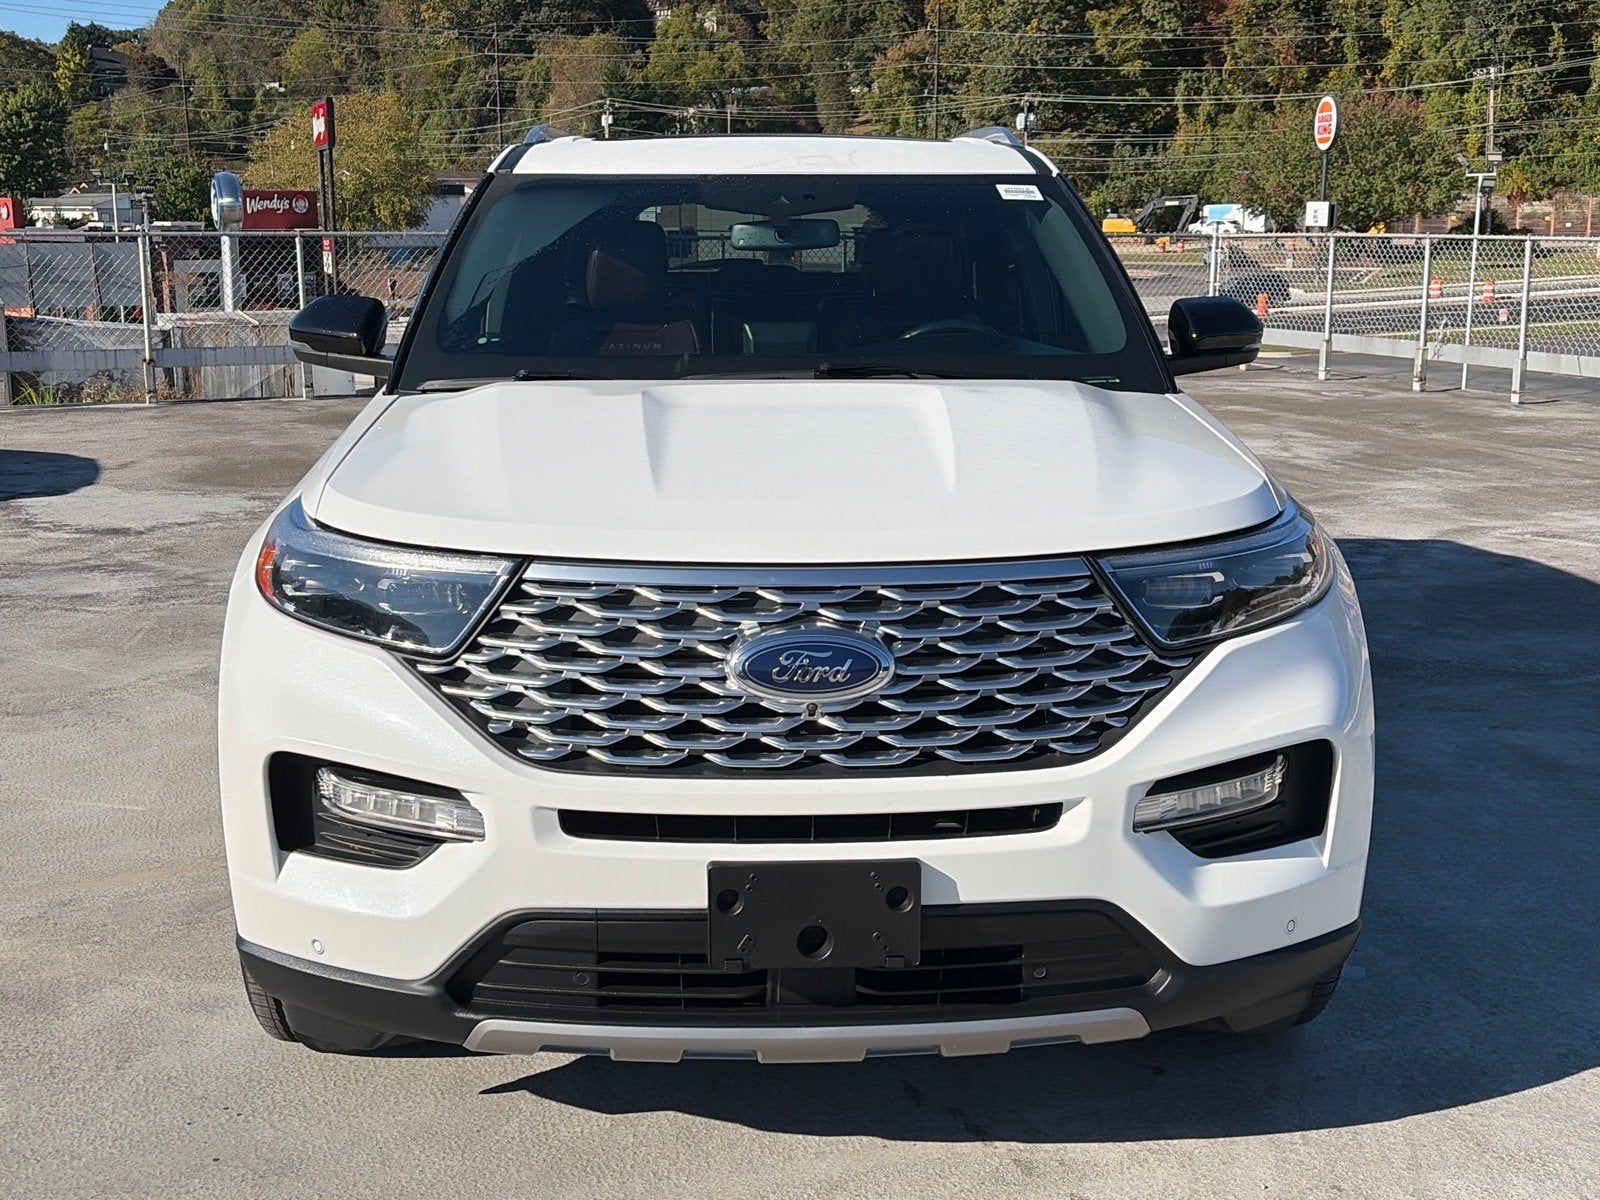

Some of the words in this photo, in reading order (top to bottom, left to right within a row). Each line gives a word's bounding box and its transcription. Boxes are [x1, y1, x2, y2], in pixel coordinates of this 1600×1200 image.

[1316, 124, 1332, 136] KING
[246, 194, 290, 214] Wendy's
[771, 650, 853, 684] Ford
